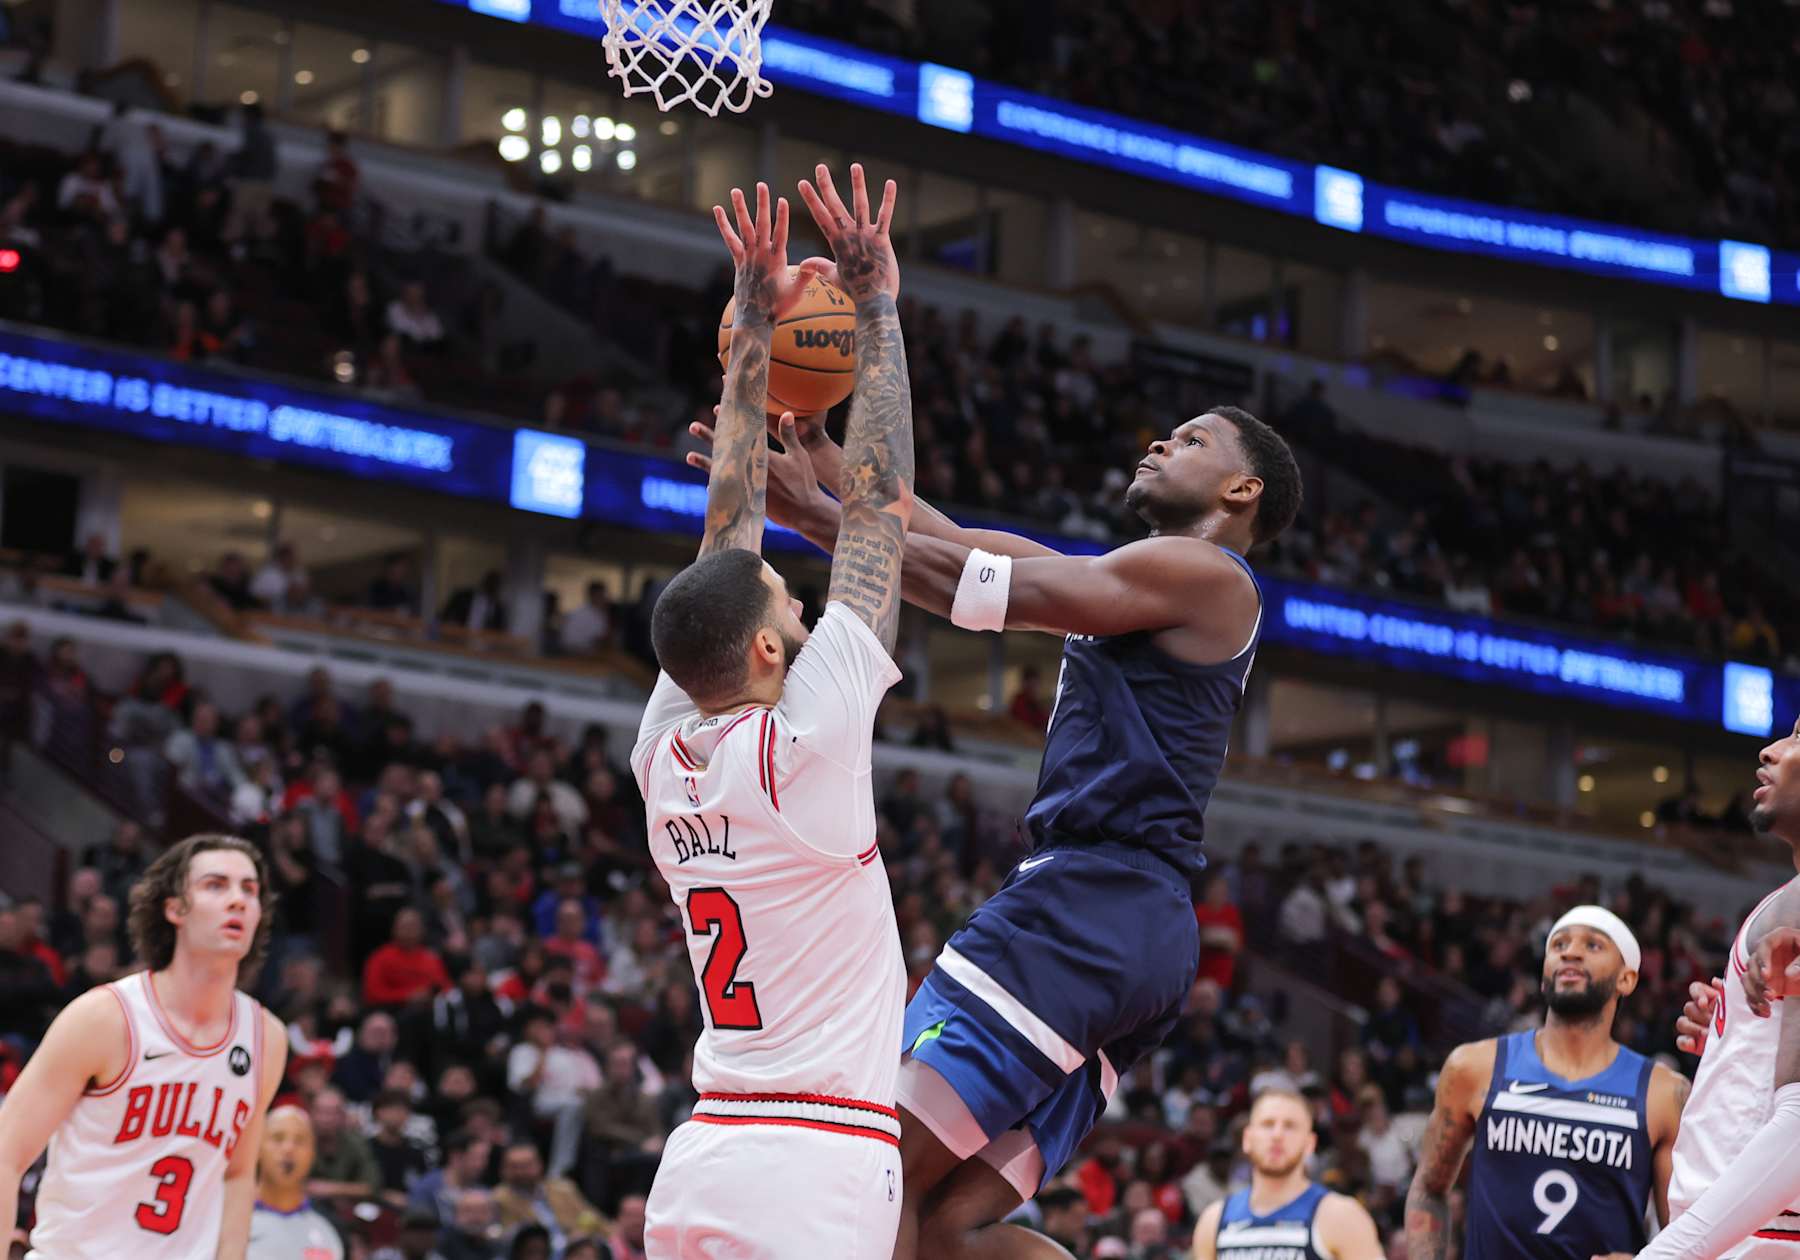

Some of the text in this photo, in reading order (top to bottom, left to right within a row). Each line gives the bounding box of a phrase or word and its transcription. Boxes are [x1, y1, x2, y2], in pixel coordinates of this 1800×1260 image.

[114, 376, 149, 413] IS
[979, 566, 996, 583] 5
[665, 814, 736, 864] BALL
[686, 887, 763, 1030] 2
[113, 1082, 249, 1161] BULLS
[1486, 1115, 1632, 1170] MINNESOTA
[134, 1155, 195, 1235] 3
[1532, 1168, 1579, 1234] 9
